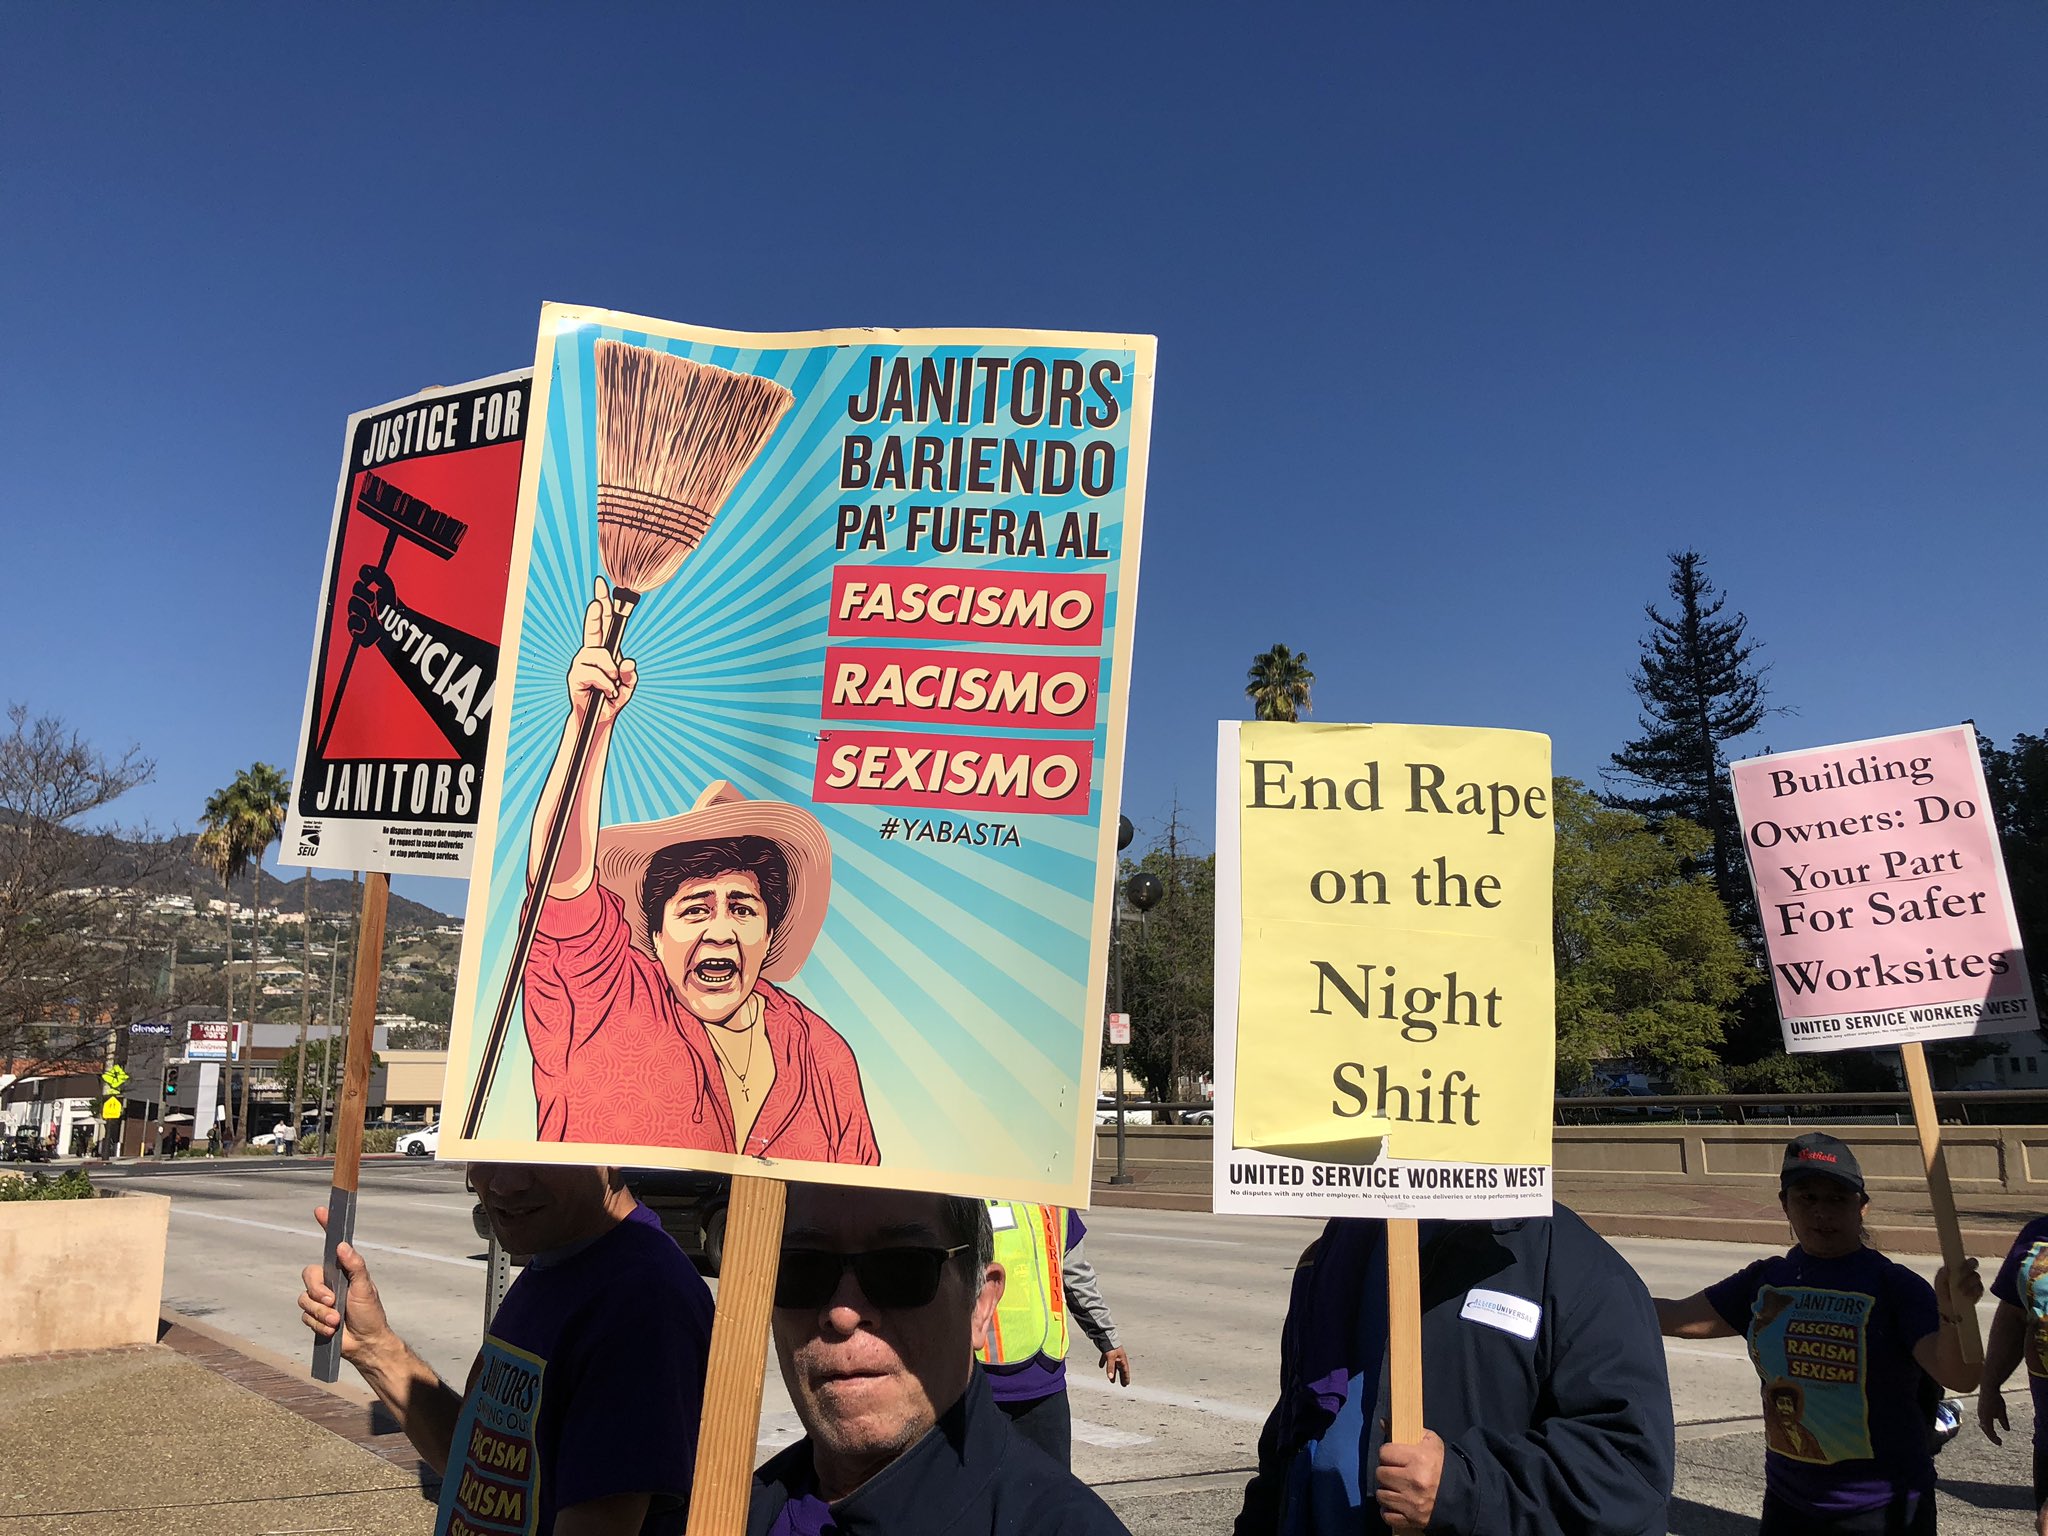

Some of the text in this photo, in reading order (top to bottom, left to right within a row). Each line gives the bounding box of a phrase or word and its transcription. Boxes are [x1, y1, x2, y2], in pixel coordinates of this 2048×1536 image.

[848, 356, 1122, 429] JANITORS
[362, 389, 522, 467] JUSTICE FOR
[839, 435, 1116, 498] BARIENDO
[905, 506, 1047, 558] FUERA
[1055, 512, 1110, 559] AL
[838, 582, 1095, 631] FASCISMO
[378, 604, 496, 736] JUSTICIA!
[831, 663, 1089, 716] RACISMO
[316, 763, 476, 816] JANITORS
[825, 744, 1080, 800] SEXISMO
[1768, 755, 1935, 799] Building
[1245, 759, 1548, 835] End Rape
[382, 826, 473, 838] No disputes with any other employer.
[389, 838, 396, 846] No
[416, 839, 421, 847] to
[422, 840, 437, 848] cease
[438, 841, 464, 849] deliveries
[879, 817, 1022, 847] #YABASTA
[1750, 795, 1976, 849] Owners: Do
[297, 846, 318, 857] SEIU
[396, 850, 408, 858] stop
[408, 850, 436, 860] performing
[436, 852, 460, 860] services.
[1779, 849, 1964, 893] Your Part
[1310, 856, 1503, 909] on the
[1774, 885, 1986, 937] For Safer
[1776, 947, 2010, 996] Worksites
[1309, 959, 1503, 1043] Night
[1790, 1019, 1841, 1035] UNITED
[1845, 1011, 1906, 1030] SERVICE
[1910, 1003, 1983, 1023] WORKERS
[1986, 999, 2029, 1015] WEST
[1332, 1061, 1481, 1127] Shift
[1230, 1163, 1546, 1189] UNITED SERVICE WORKERS WEST
[1795, 1293, 1865, 1315] JANITORS
[1787, 1339, 1857, 1365] RACISM
[1788, 1322, 1855, 1340] FASCISM
[1791, 1360, 1855, 1382] SEXISM
